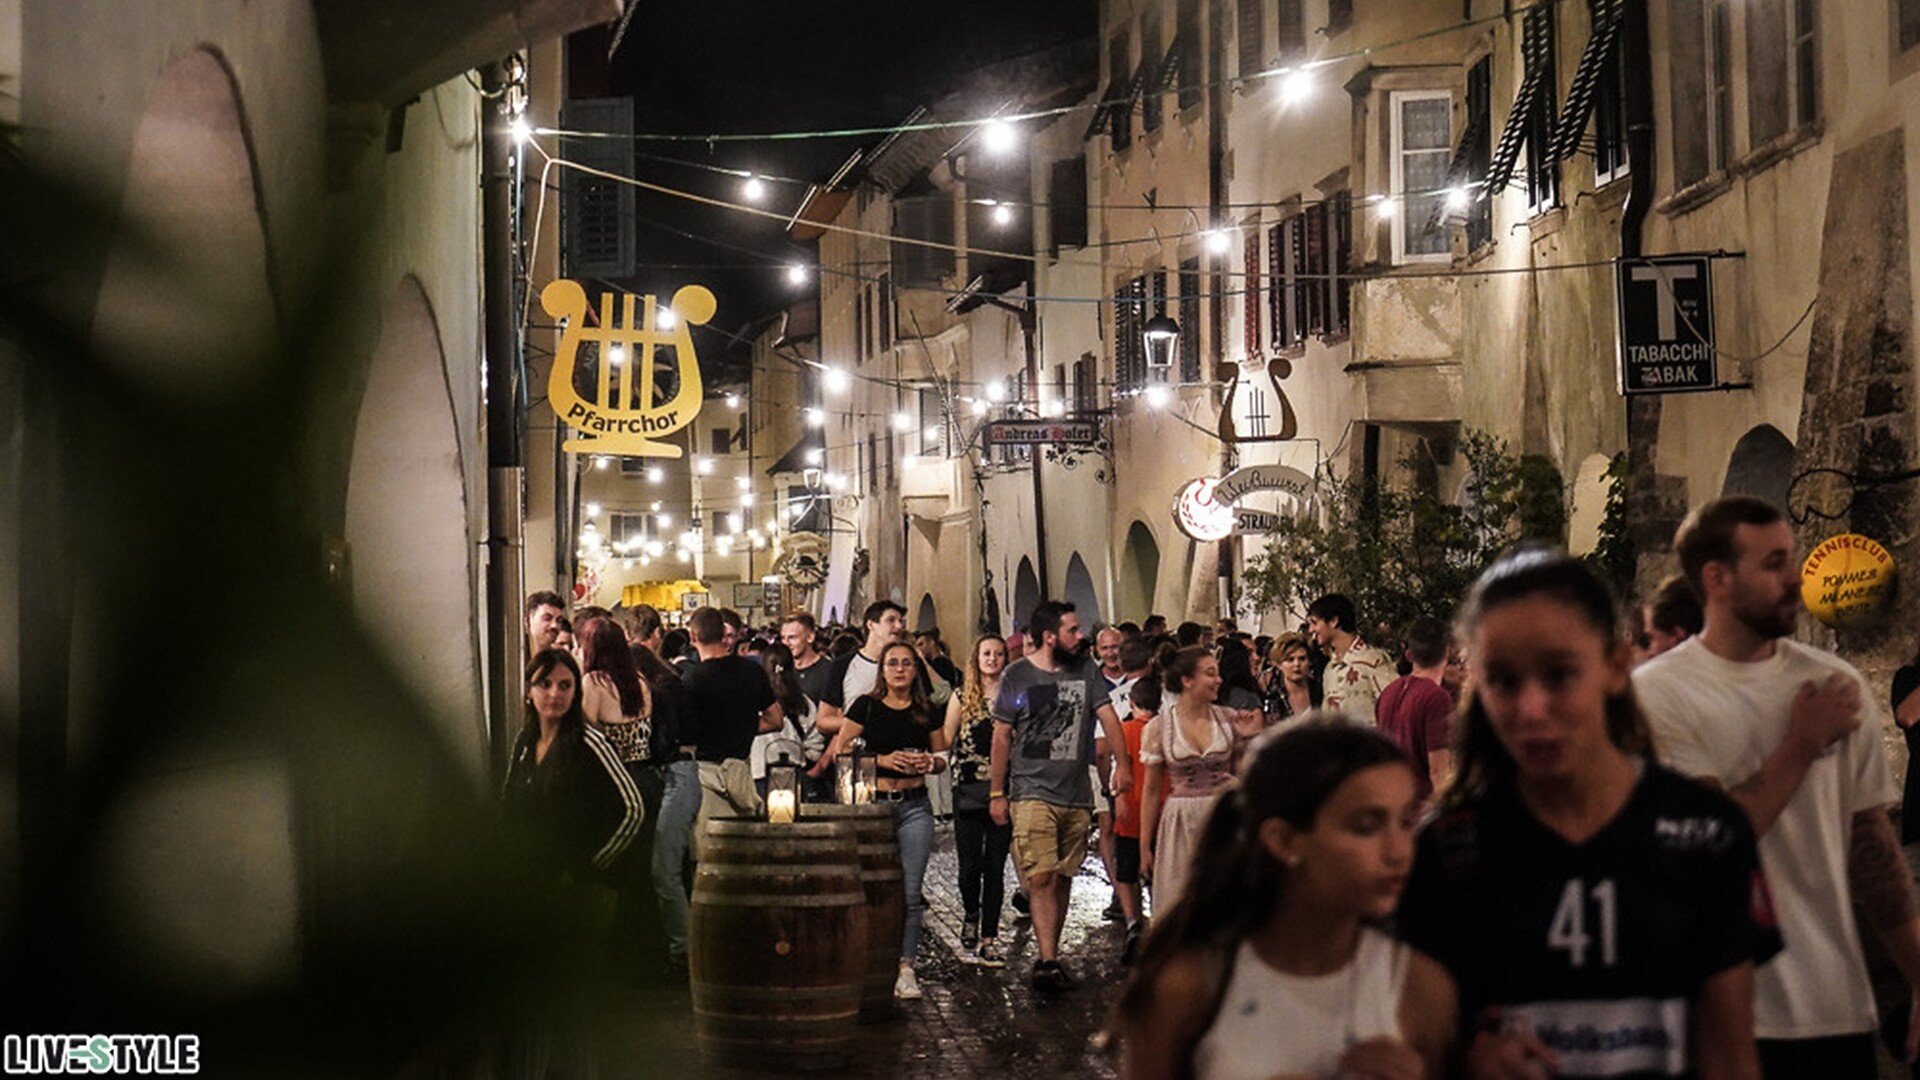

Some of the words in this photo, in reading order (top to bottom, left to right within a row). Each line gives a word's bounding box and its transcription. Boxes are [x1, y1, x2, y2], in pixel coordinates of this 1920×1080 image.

[1629, 344, 1708, 362] TABACCHI
[1641, 365, 1698, 384] TABAK
[567, 403, 678, 434] Pfarrchor
[992, 426, 1048, 440] Andreas
[1804, 536, 1889, 577] TENNISCLUB
[1822, 568, 1878, 587] POMMES
[1547, 877, 1619, 966] 41
